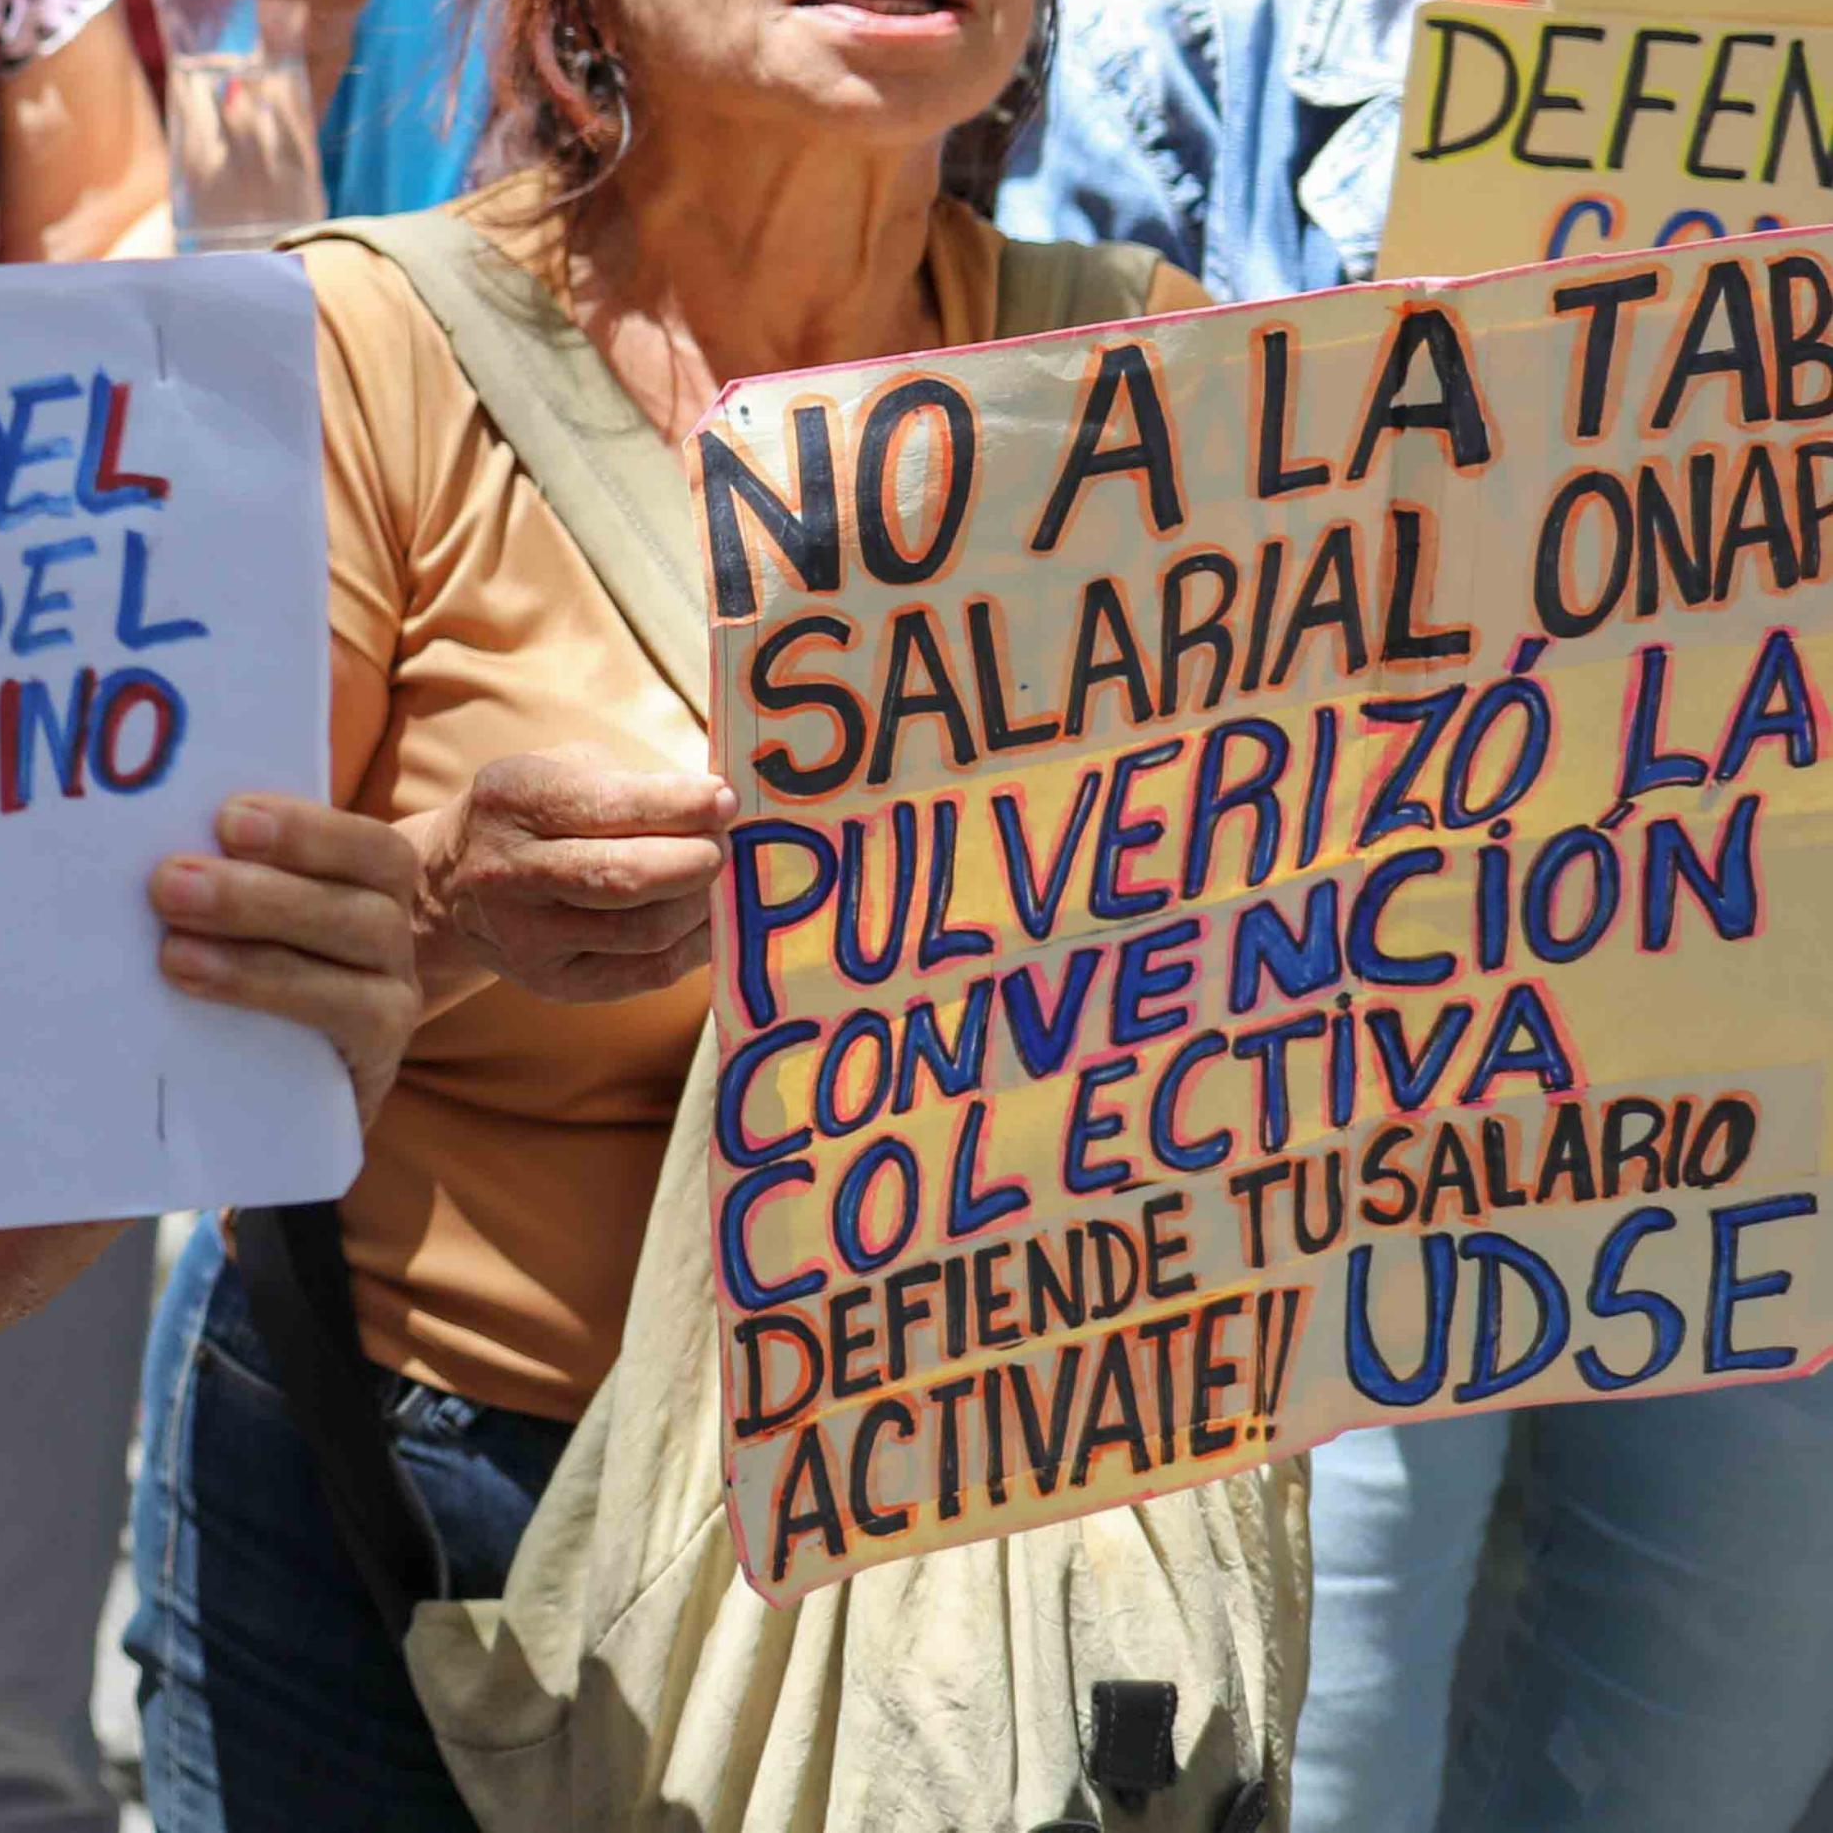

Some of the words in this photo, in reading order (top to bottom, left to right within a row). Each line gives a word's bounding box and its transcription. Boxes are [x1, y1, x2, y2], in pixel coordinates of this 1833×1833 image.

[695, 375, 975, 620] NO
[1031, 343, 1183, 553] A
[1256, 308, 1493, 497] LA
[1554, 255, 1833, 438] TAB
[732, 637, 1550, 1030] PULVERIZÓ
[1617, 631, 1819, 800] LA
[750, 509, 1470, 798] SALARIAL
[715, 794, 1759, 1168] CONVENCIÓN
[719, 984, 1575, 1312] COLECTIVA
[734, 1181, 1197, 1439] DEFIENDE
[1233, 1153, 1344, 1270] TU
[1358, 1097, 1758, 1228] SALARIO
[772, 1288, 1303, 1582] ACTIVATE!!
[1344, 1192, 1819, 1408] UDSE
